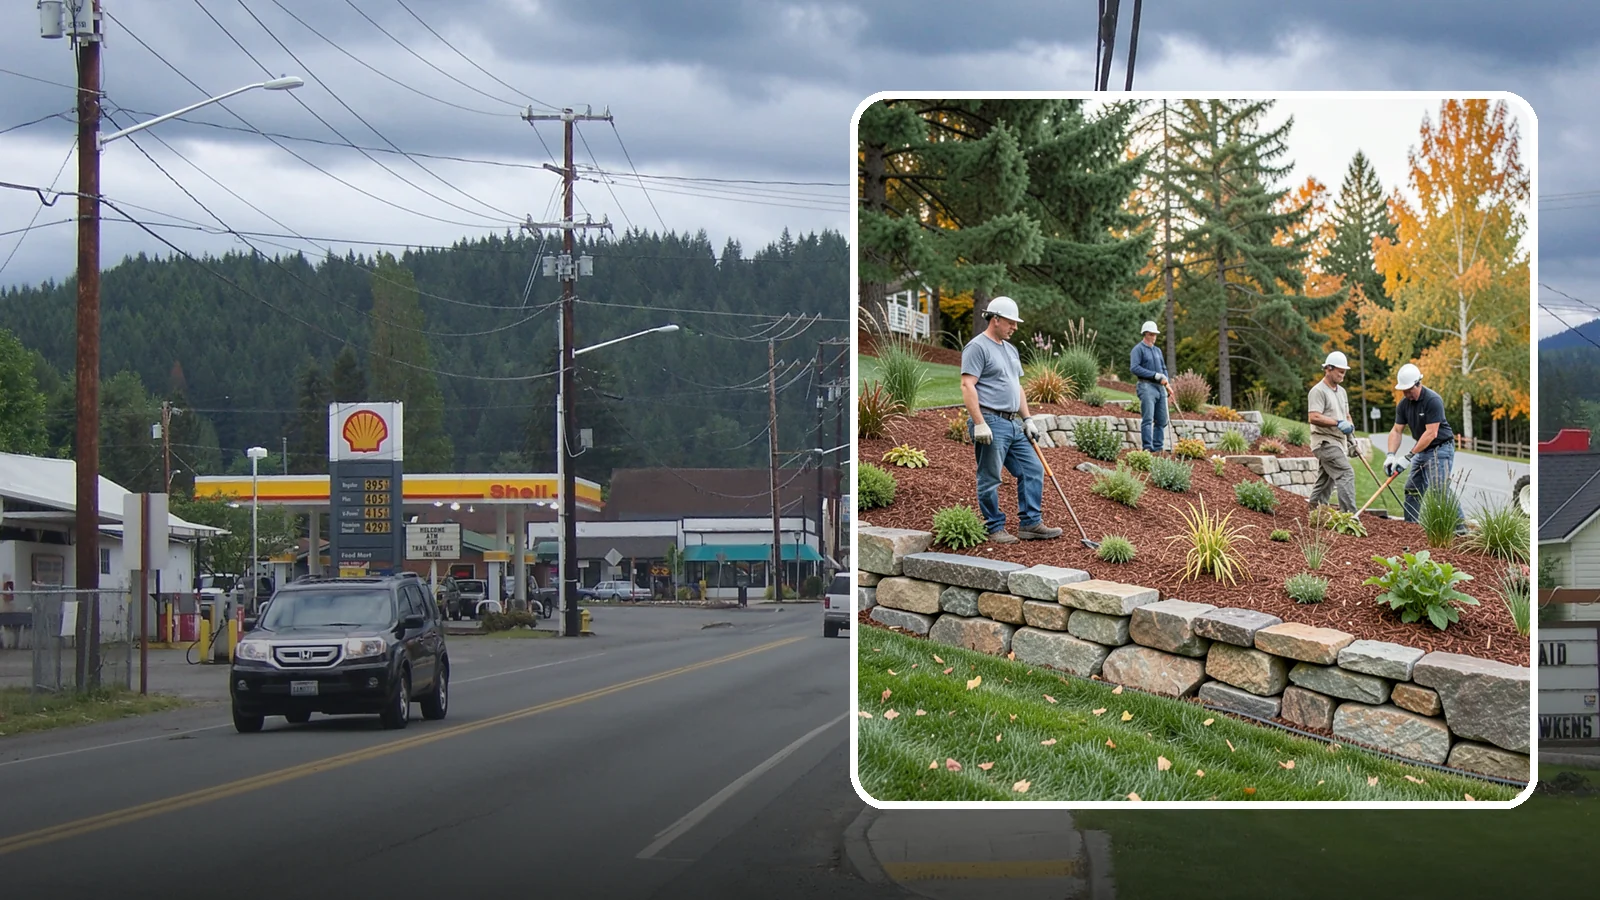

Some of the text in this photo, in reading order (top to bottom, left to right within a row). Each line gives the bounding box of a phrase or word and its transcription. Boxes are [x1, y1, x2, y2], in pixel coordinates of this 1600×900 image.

[366, 480, 384, 490] 395
[490, 484, 547, 499] Shell
[366, 494, 384, 504] 405
[366, 508, 384, 518] 415
[366, 522, 384, 533] 429
